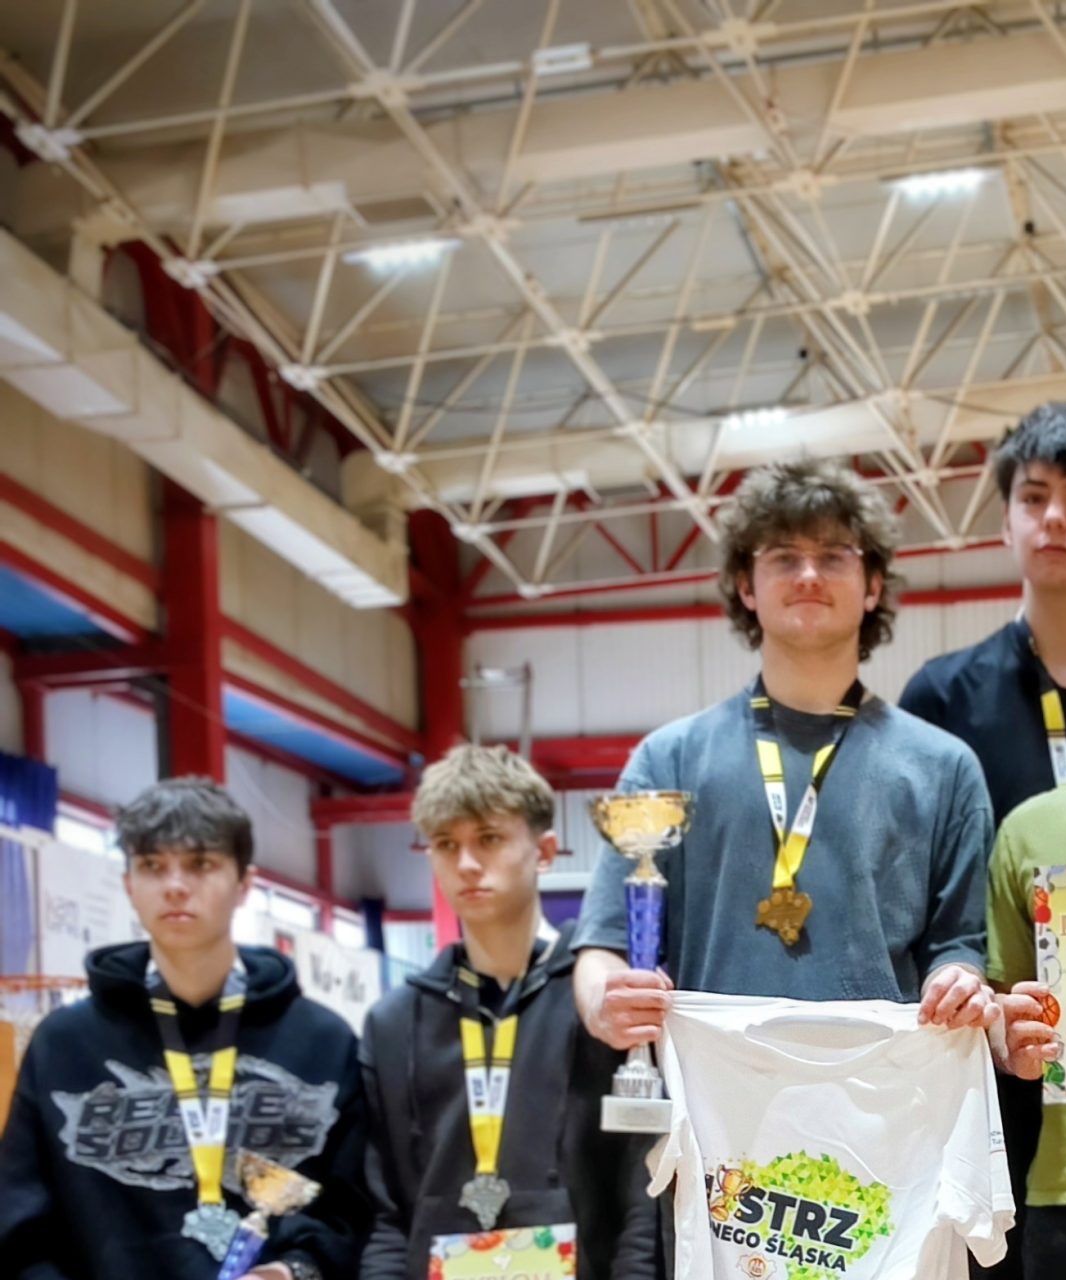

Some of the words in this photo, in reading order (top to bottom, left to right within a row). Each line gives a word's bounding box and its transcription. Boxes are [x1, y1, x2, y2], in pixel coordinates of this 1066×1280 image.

[705, 1174, 859, 1250] STRZ
[709, 1221, 761, 1249] NEGO
[765, 1232, 847, 1272] ŚLĄSKA
